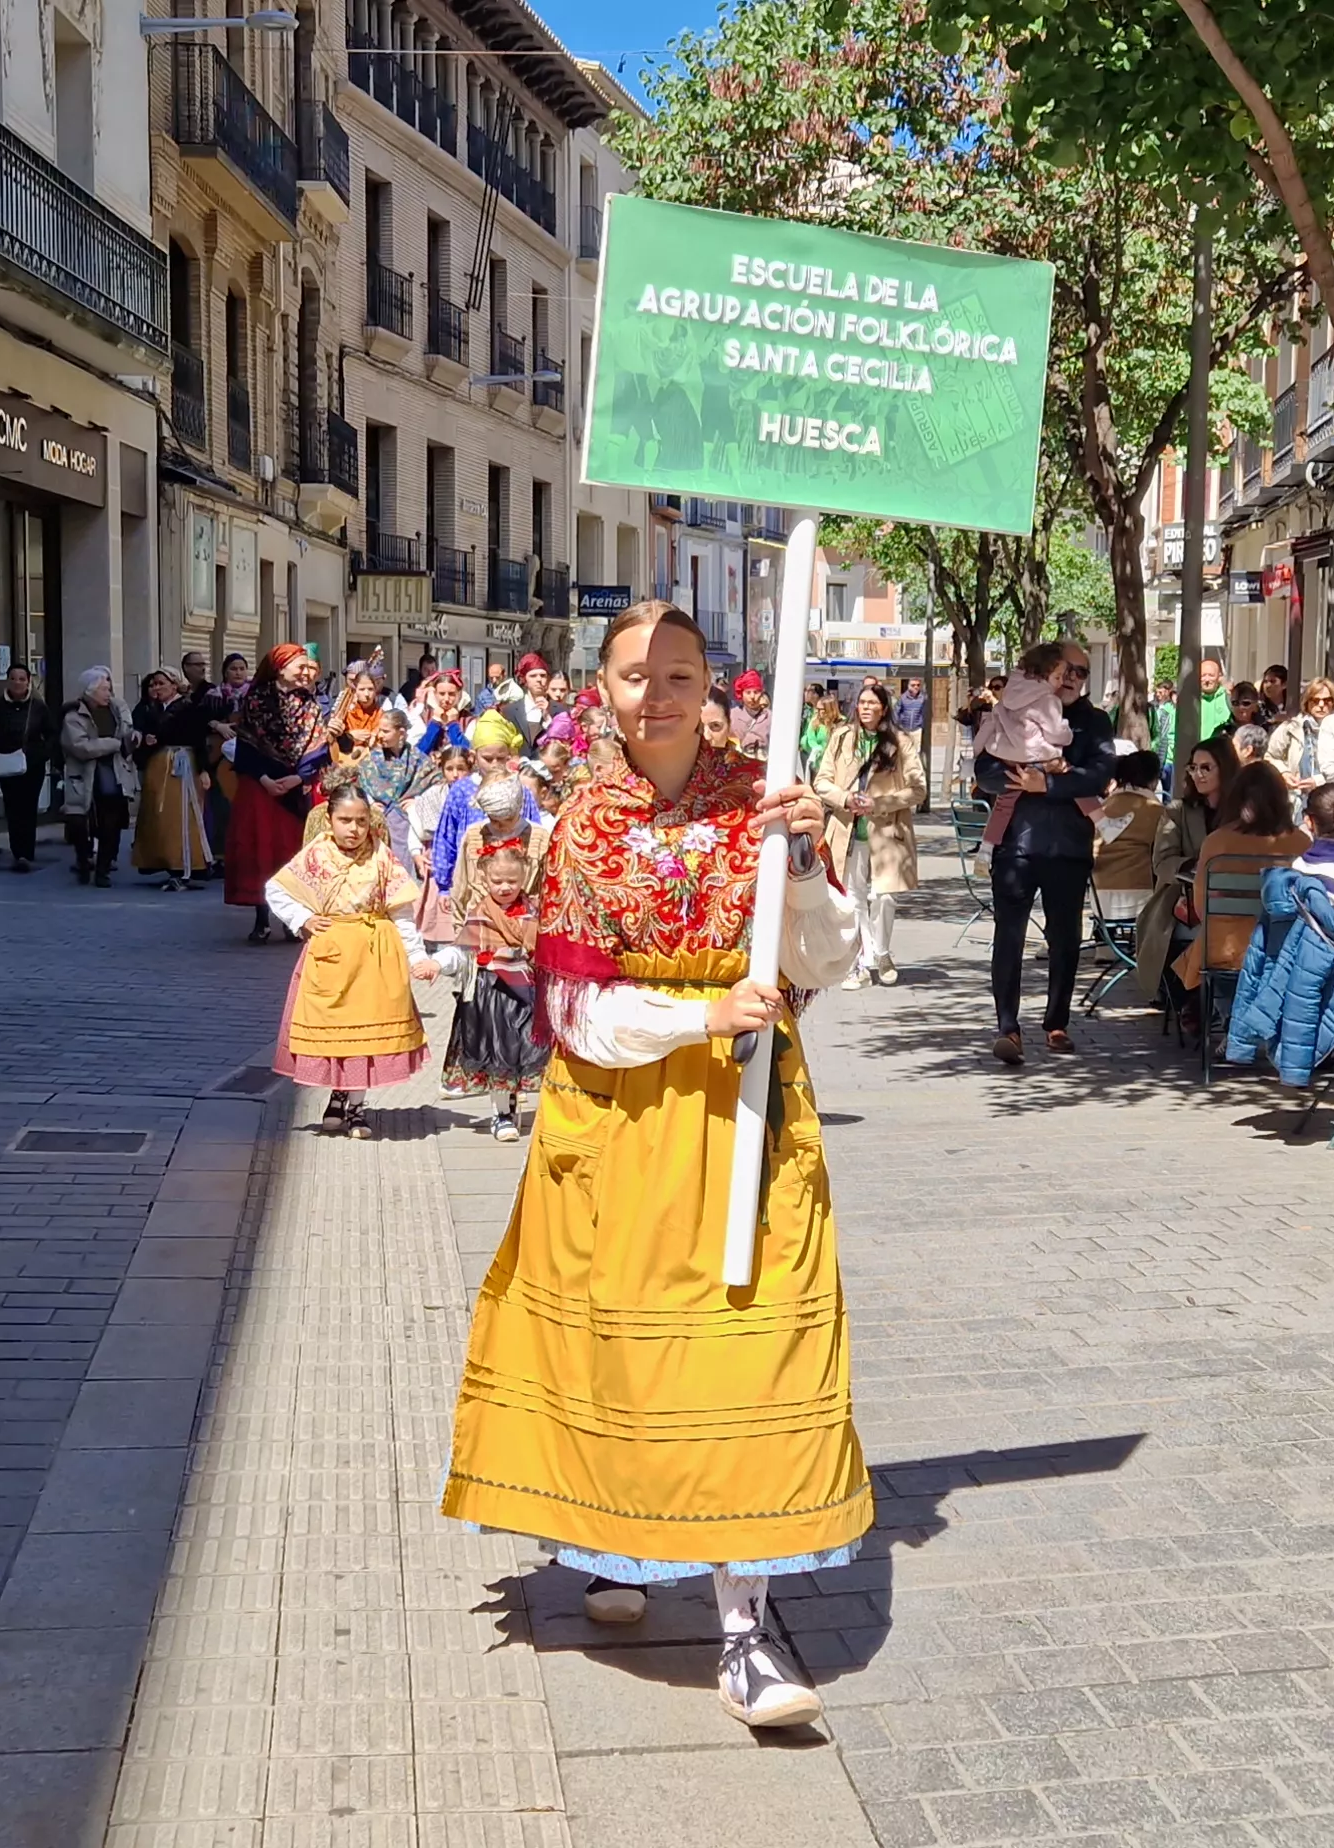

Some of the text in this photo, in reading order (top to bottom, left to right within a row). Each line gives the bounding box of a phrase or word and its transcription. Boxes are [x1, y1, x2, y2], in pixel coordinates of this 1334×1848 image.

[731, 254, 940, 313] ESCUELA DE LA
[637, 284, 837, 338] AGRUPACIÓN
[841, 312, 1018, 365] FOLKLÓRICA
[723, 338, 818, 379] SANTA
[825, 354, 933, 394] CECILIA
[759, 412, 882, 456] HUESCA
[42, 439, 67, 468] MODA
[70, 449, 97, 477] HOGAR
[361, 576, 424, 613] ASCASO
[580, 594, 629, 608] Arenas
